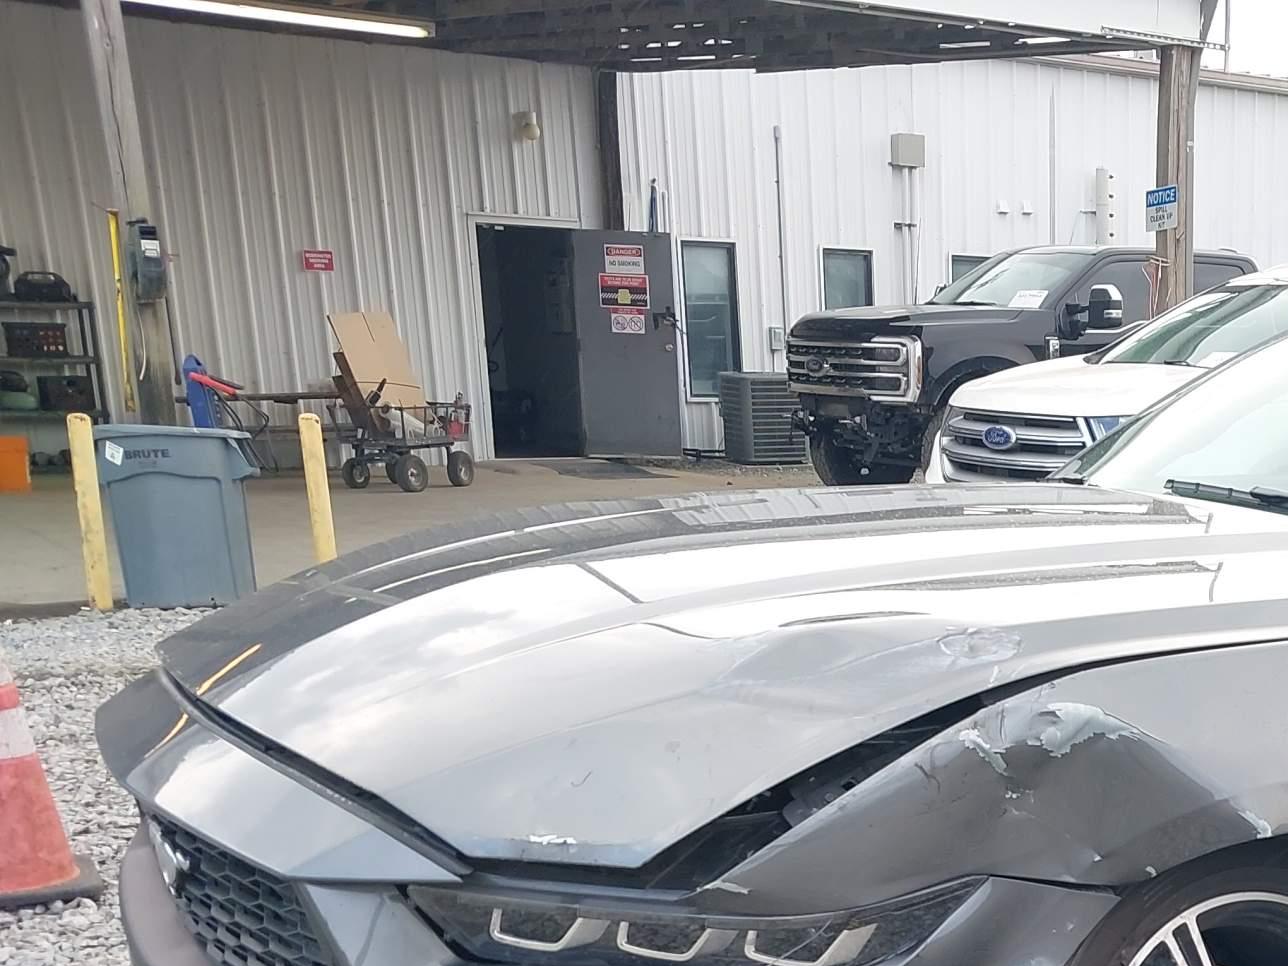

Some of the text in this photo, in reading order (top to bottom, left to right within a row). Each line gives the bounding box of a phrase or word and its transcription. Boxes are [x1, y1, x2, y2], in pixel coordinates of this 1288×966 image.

[1147, 189, 1176, 206] NOTICE
[611, 247, 638, 256] DANGER
[618, 260, 641, 268] SMOKING
[124, 448, 170, 460] BRUTE
